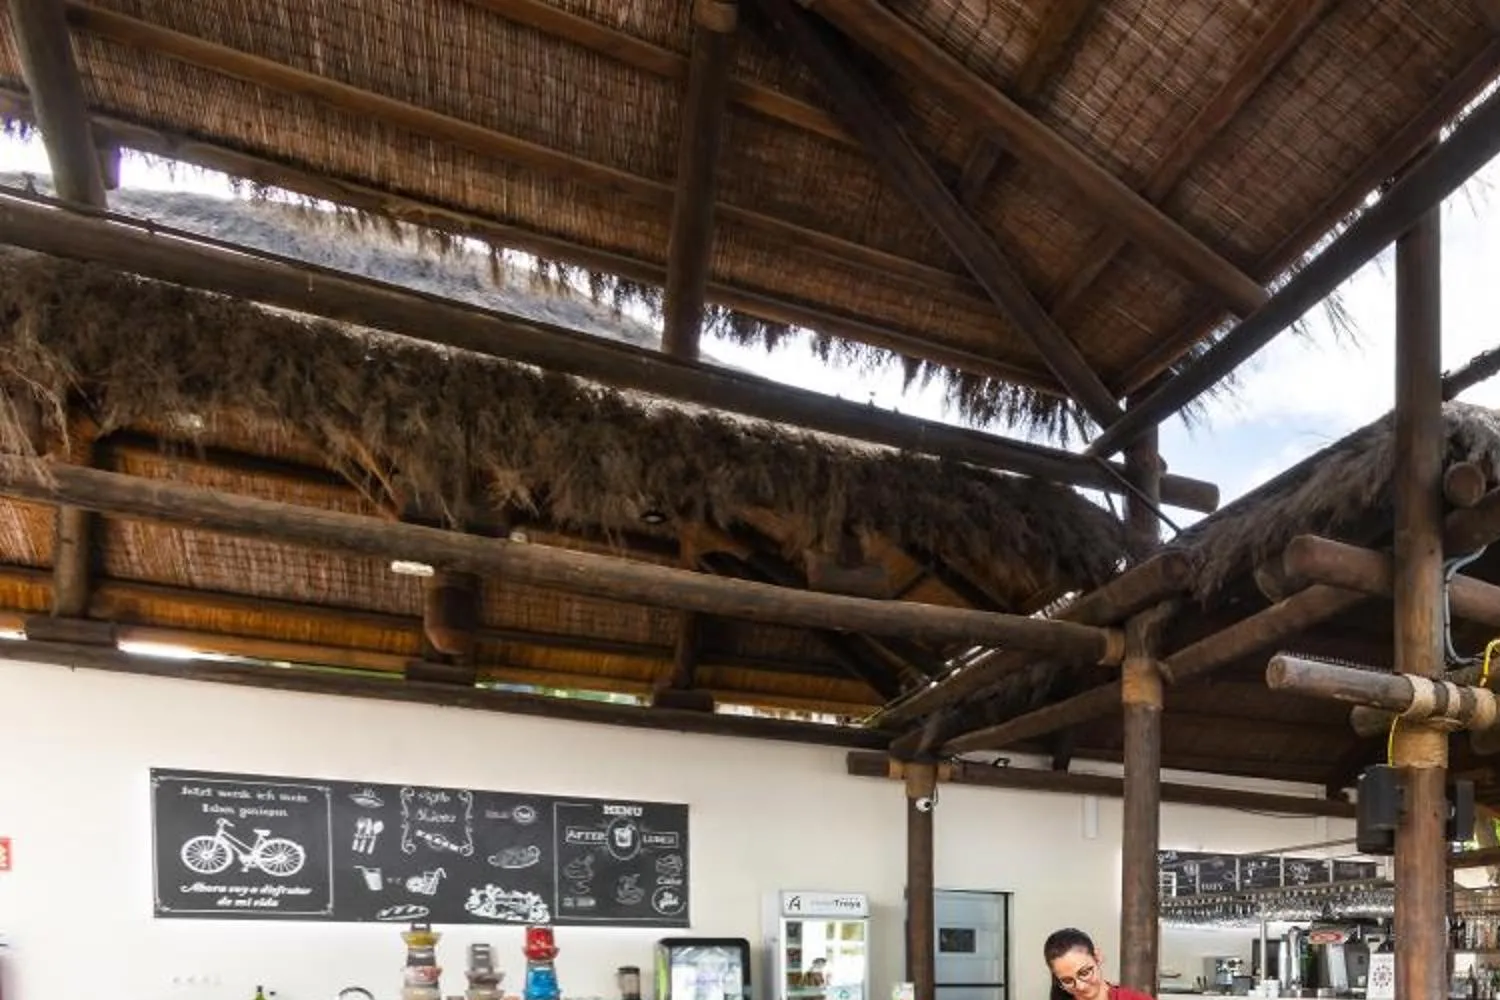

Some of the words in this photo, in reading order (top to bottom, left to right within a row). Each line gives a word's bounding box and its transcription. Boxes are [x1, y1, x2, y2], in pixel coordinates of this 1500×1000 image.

[603, 804, 642, 817] MENU
[566, 829, 606, 842] AFTER
[179, 881, 227, 893] Ahora
[259, 884, 313, 898] disfrutar
[216, 895, 232, 906] de
[234, 897, 251, 907] mi
[253, 896, 281, 908] vida
